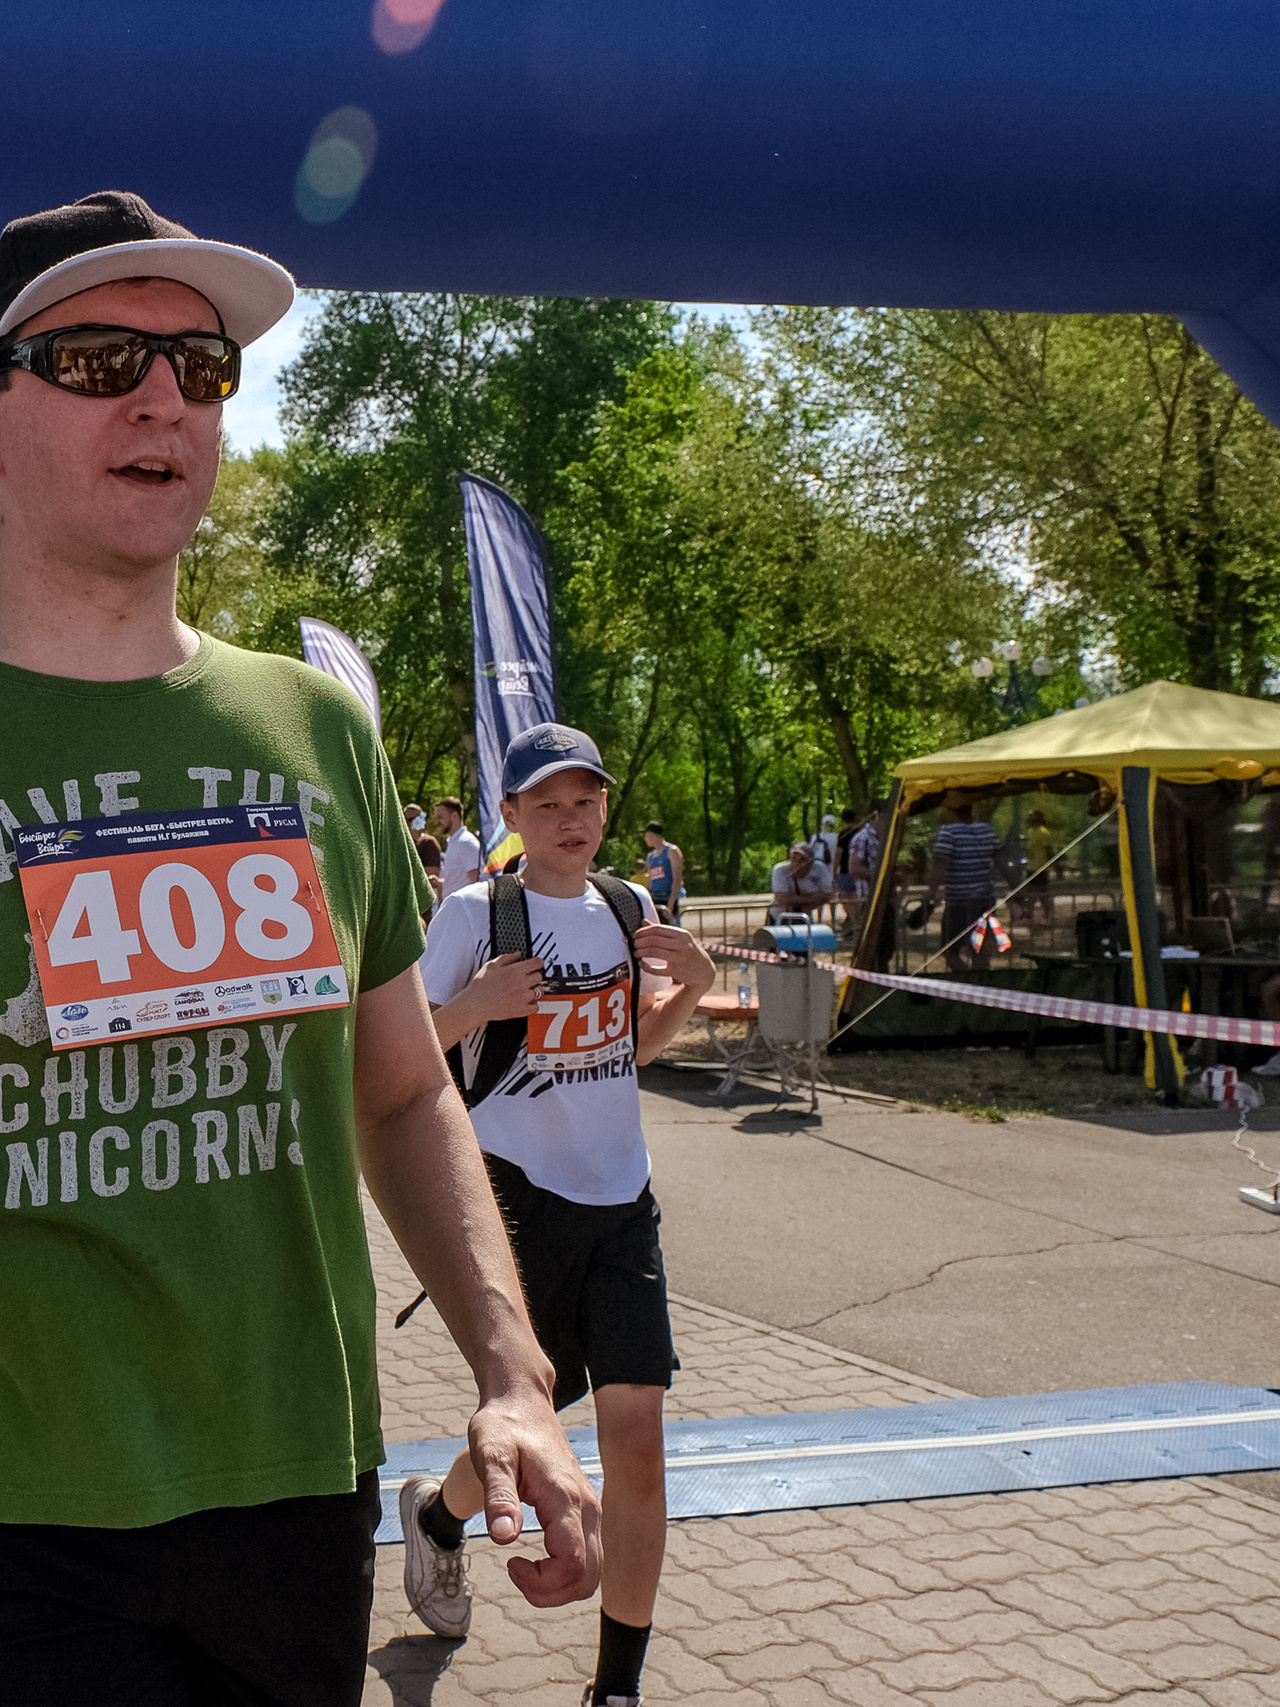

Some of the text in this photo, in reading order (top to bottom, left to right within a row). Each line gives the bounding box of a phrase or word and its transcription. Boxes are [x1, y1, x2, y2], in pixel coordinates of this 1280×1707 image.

[95, 824, 144, 837] ФЕСТИВАЛЬ
[145, 822, 165, 832] БЕГА
[273, 818, 298, 827] РУСАЛ
[47, 852, 315, 985] 408
[537, 988, 626, 1049] 713
[554, 1053, 634, 1085] WINNER
